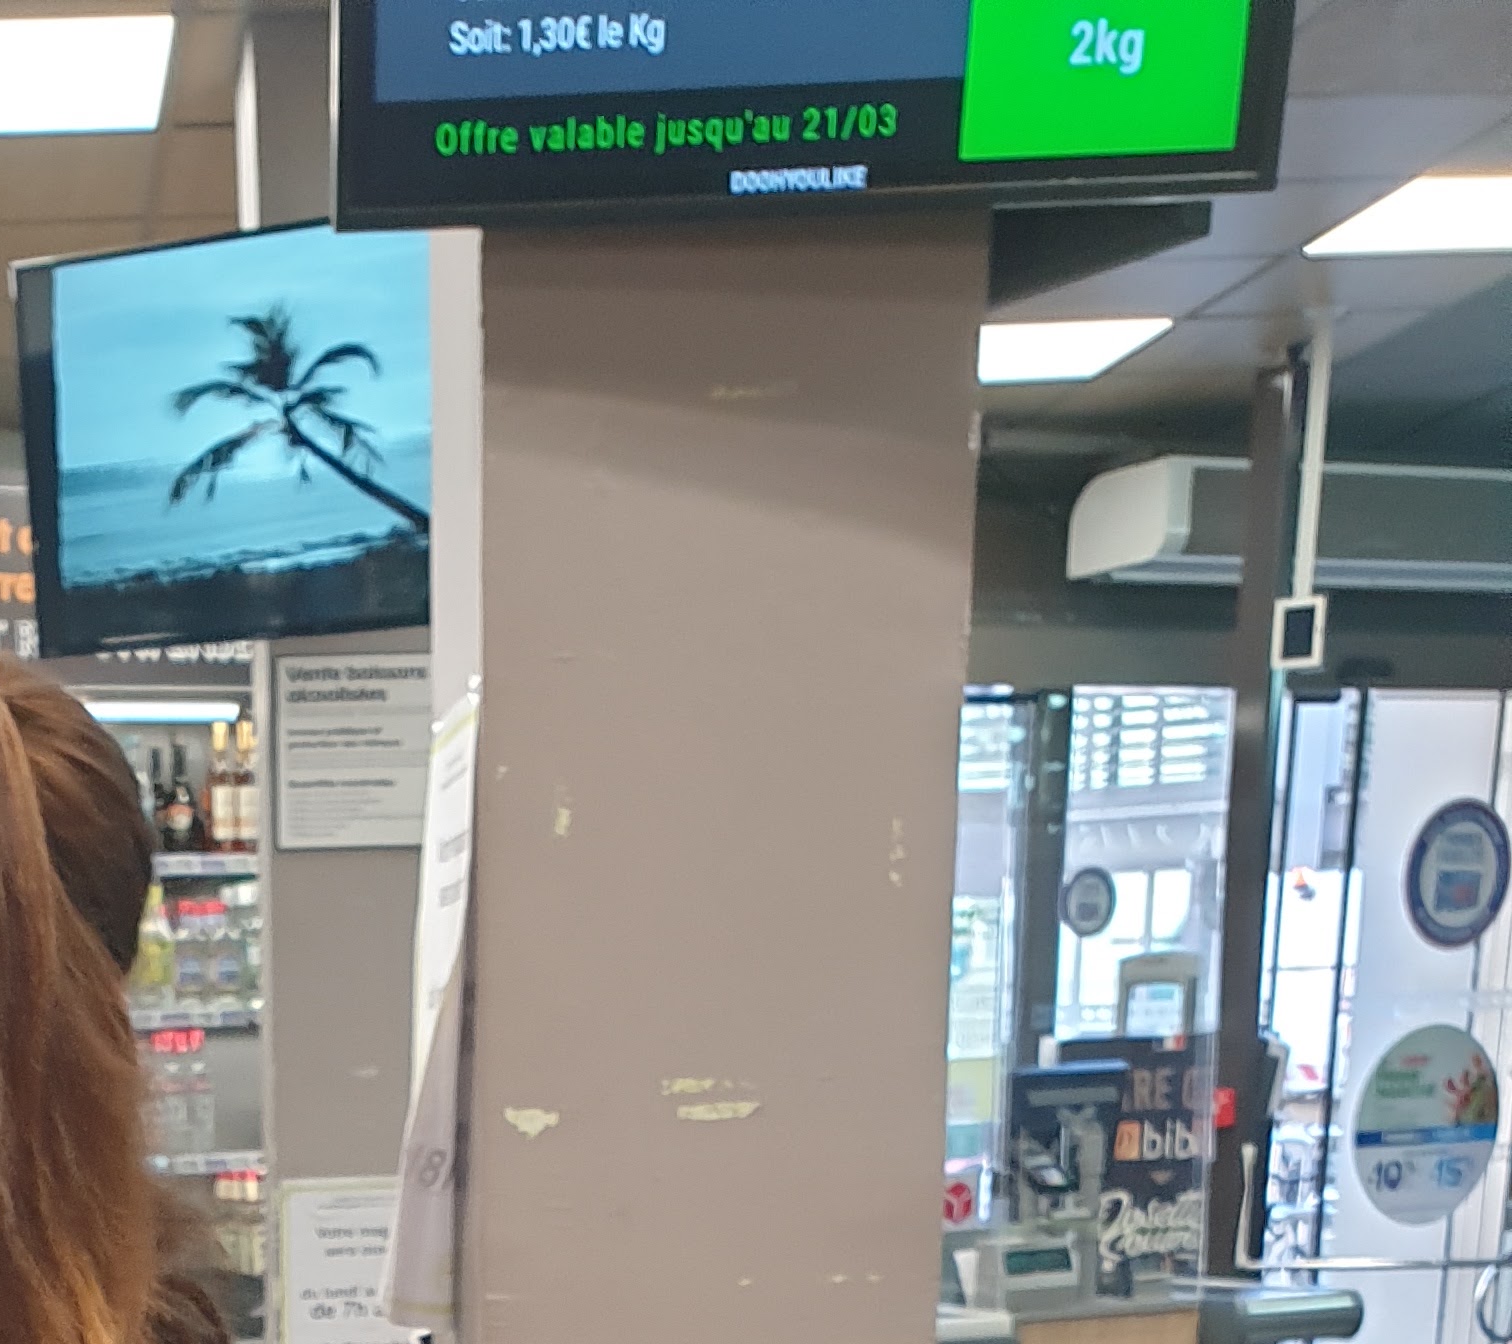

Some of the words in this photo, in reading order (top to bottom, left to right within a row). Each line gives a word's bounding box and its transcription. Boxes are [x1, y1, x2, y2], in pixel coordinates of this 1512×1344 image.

[449, 17, 512, 55] Soit:
[517, 14, 592, 57] 1,30€
[598, 15, 623, 49] le
[628, 12, 666, 53] Kg
[1068, 17, 1145, 75] 2kg
[436, 121, 518, 156] Offre
[530, 115, 645, 152] valable
[654, 109, 791, 154] jusqu'au
[803, 104, 898, 141] 21/03
